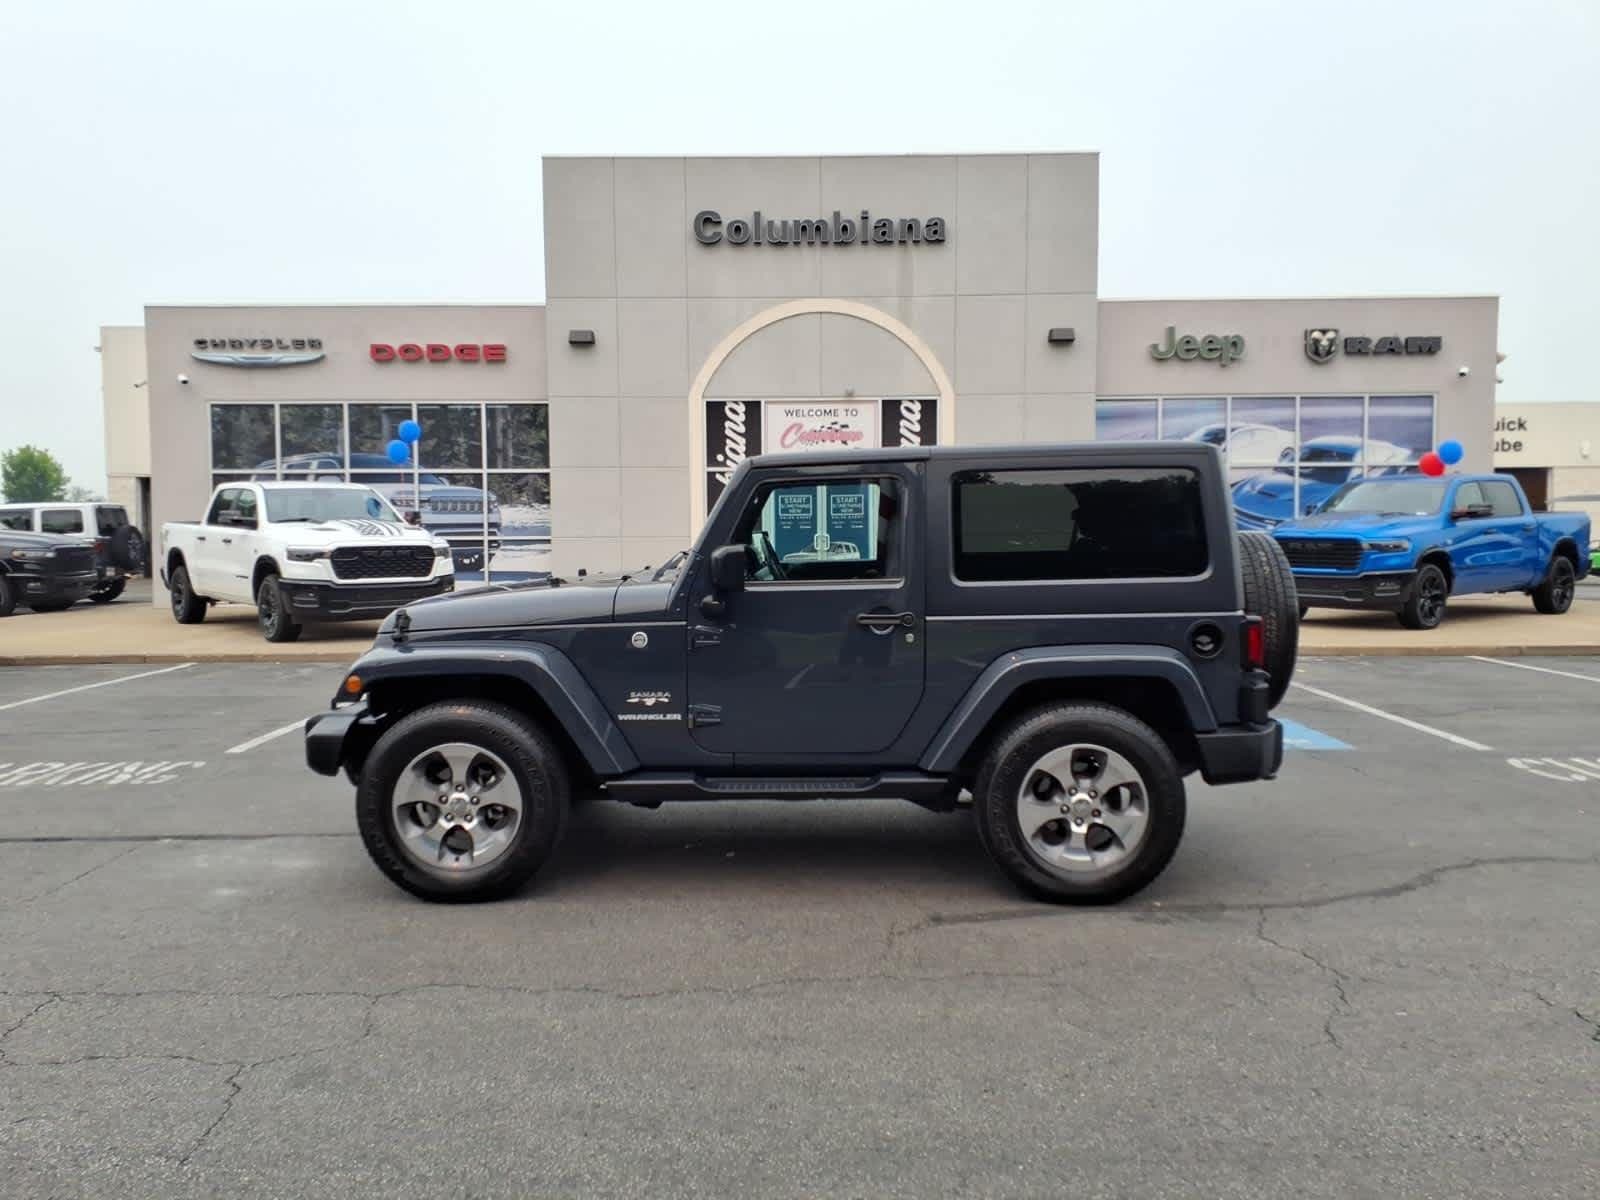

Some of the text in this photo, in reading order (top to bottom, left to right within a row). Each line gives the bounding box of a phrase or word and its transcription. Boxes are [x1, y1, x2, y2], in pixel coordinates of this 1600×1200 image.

[694, 210, 946, 244] Columbiana
[193, 338, 323, 350] CHRYSLER
[370, 344, 507, 362] DODGE
[1150, 326, 1246, 367] Jeep
[1345, 336, 1442, 355] RAM
[784, 408, 859, 417] WELCOME TO
[617, 713, 682, 721] WRANGLER
